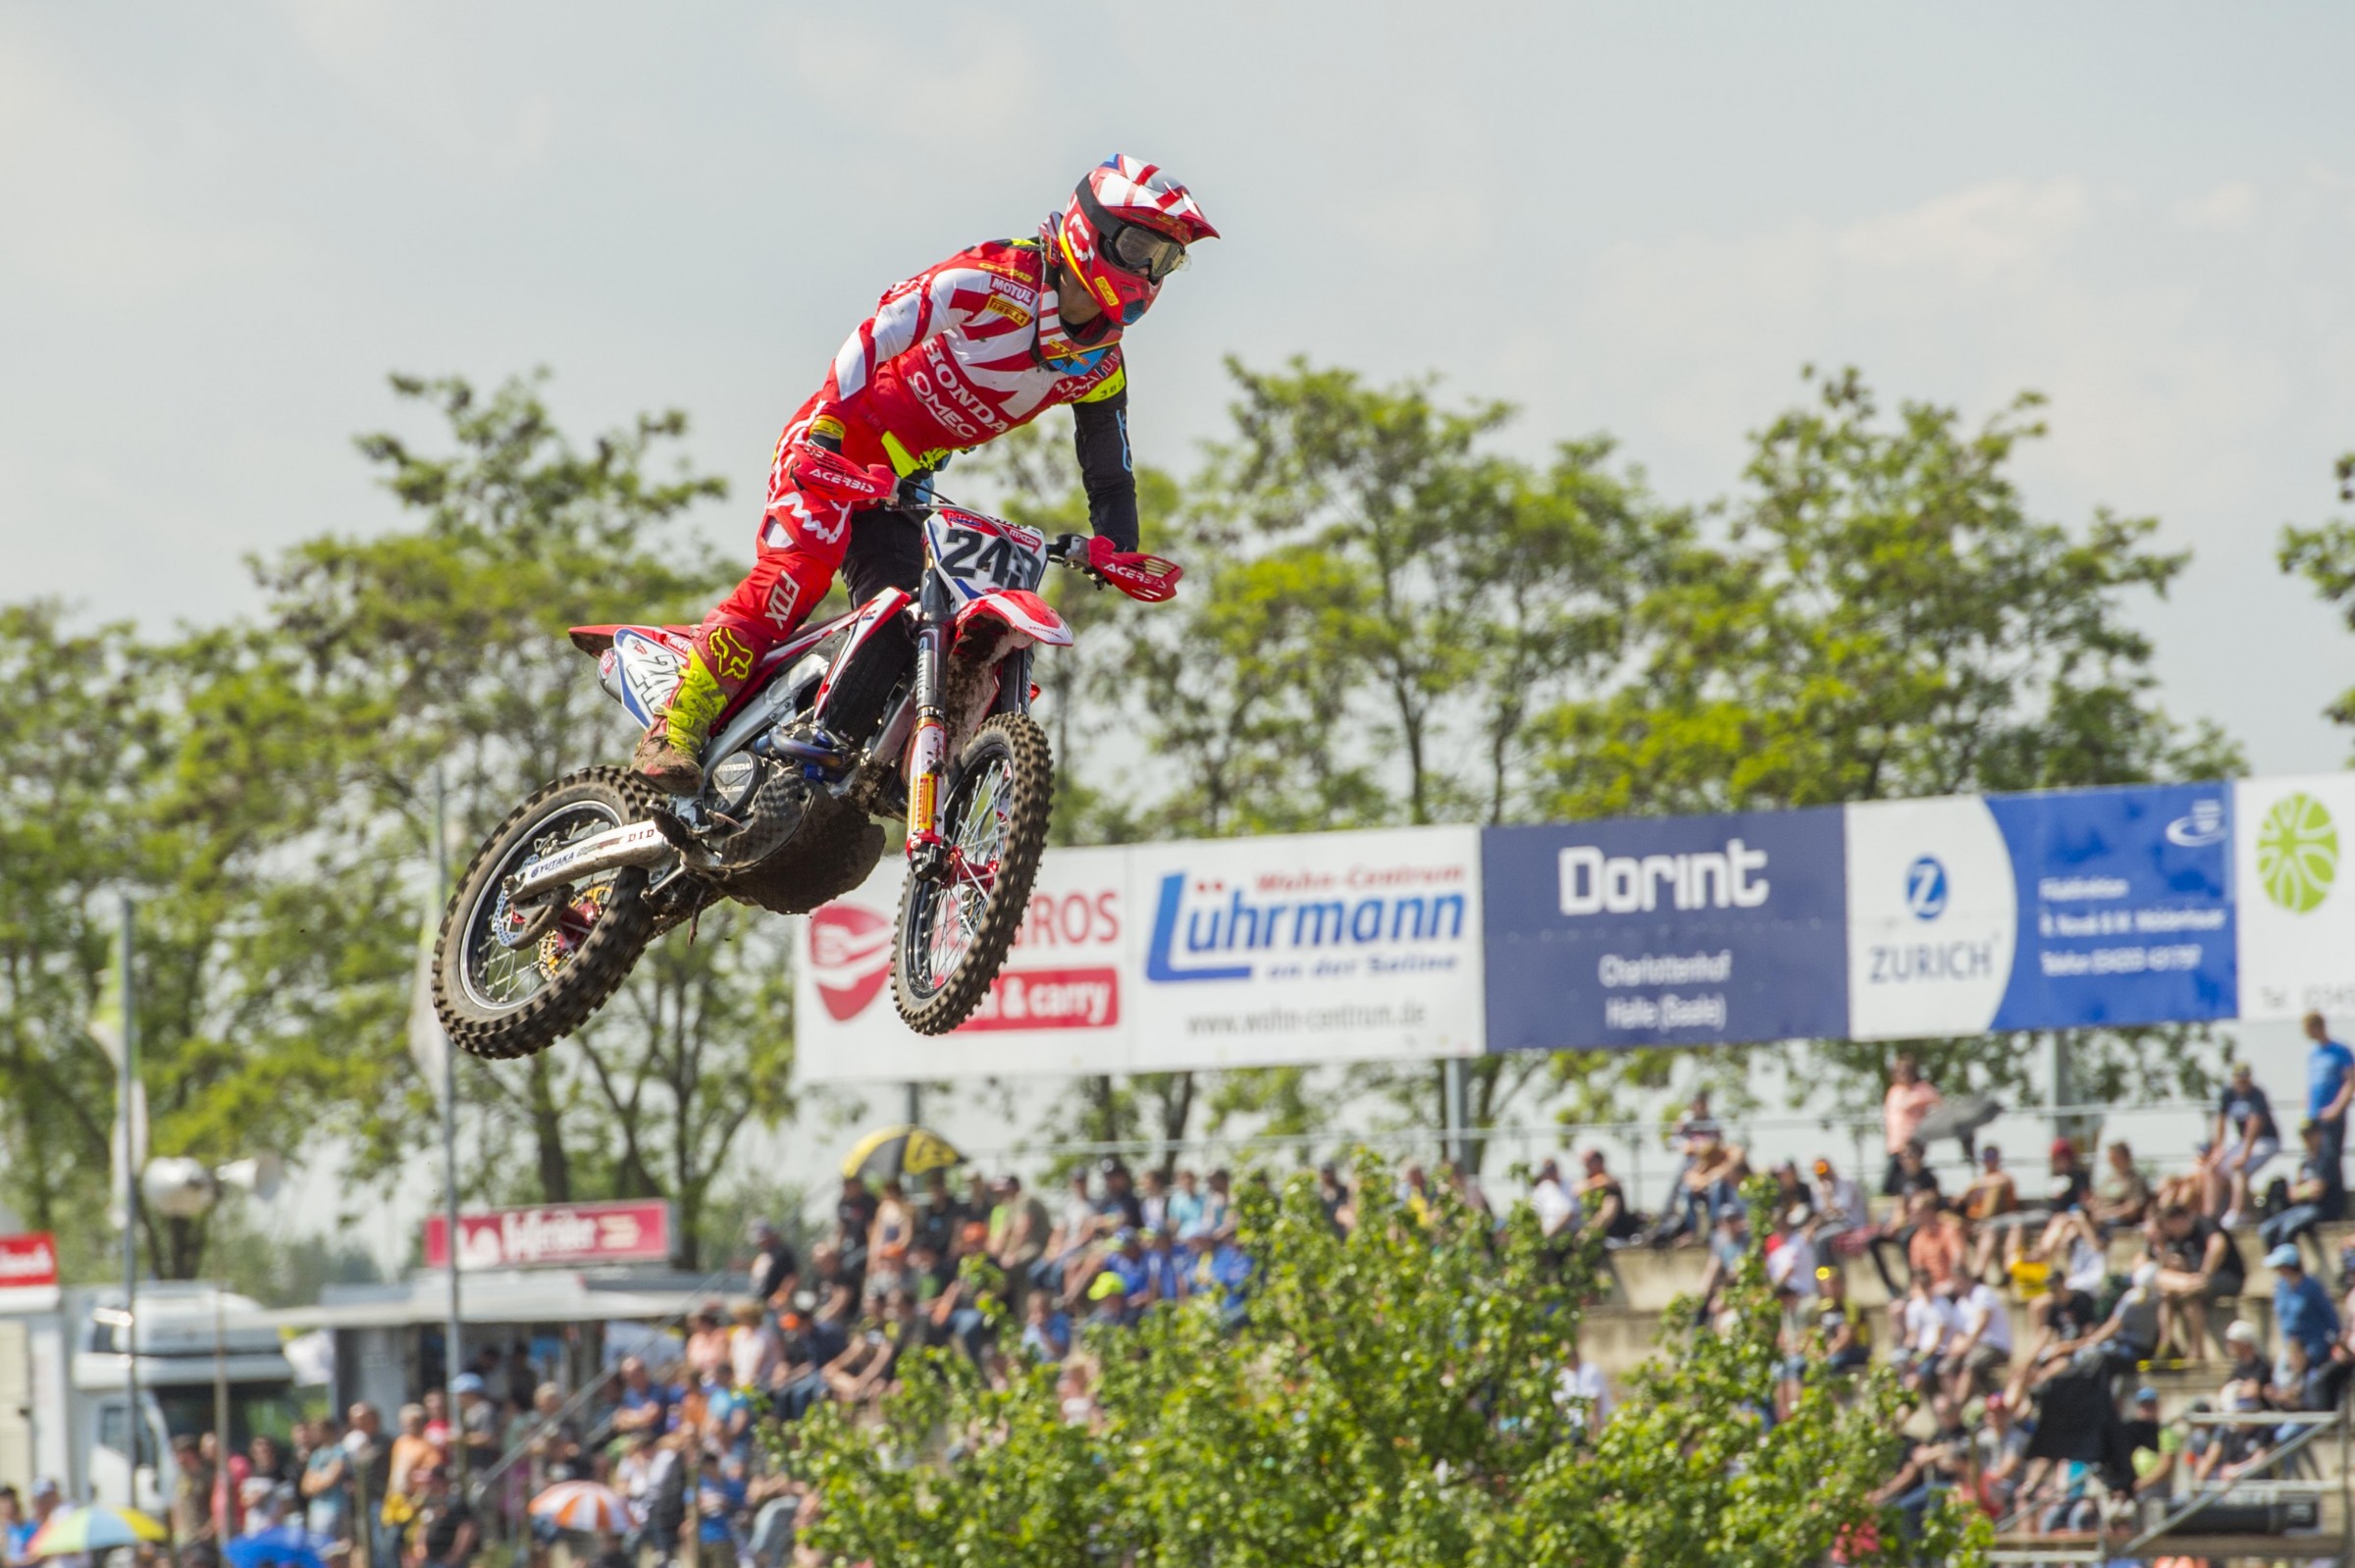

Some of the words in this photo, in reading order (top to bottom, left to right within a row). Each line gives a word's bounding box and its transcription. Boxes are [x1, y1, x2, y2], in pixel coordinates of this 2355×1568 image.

[991, 277, 1032, 303] MOTUL
[914, 371, 978, 439] OMEC
[921, 337, 1010, 433] HONDA
[940, 528, 1041, 593] 243
[764, 569, 801, 630] FOX
[540, 852, 575, 872] YUTAKA
[1558, 838, 1769, 915] Dorint
[1146, 872, 1465, 981] Lührmann
[1868, 941, 1993, 983] ZURICH
[1029, 981, 1111, 1024] carry
